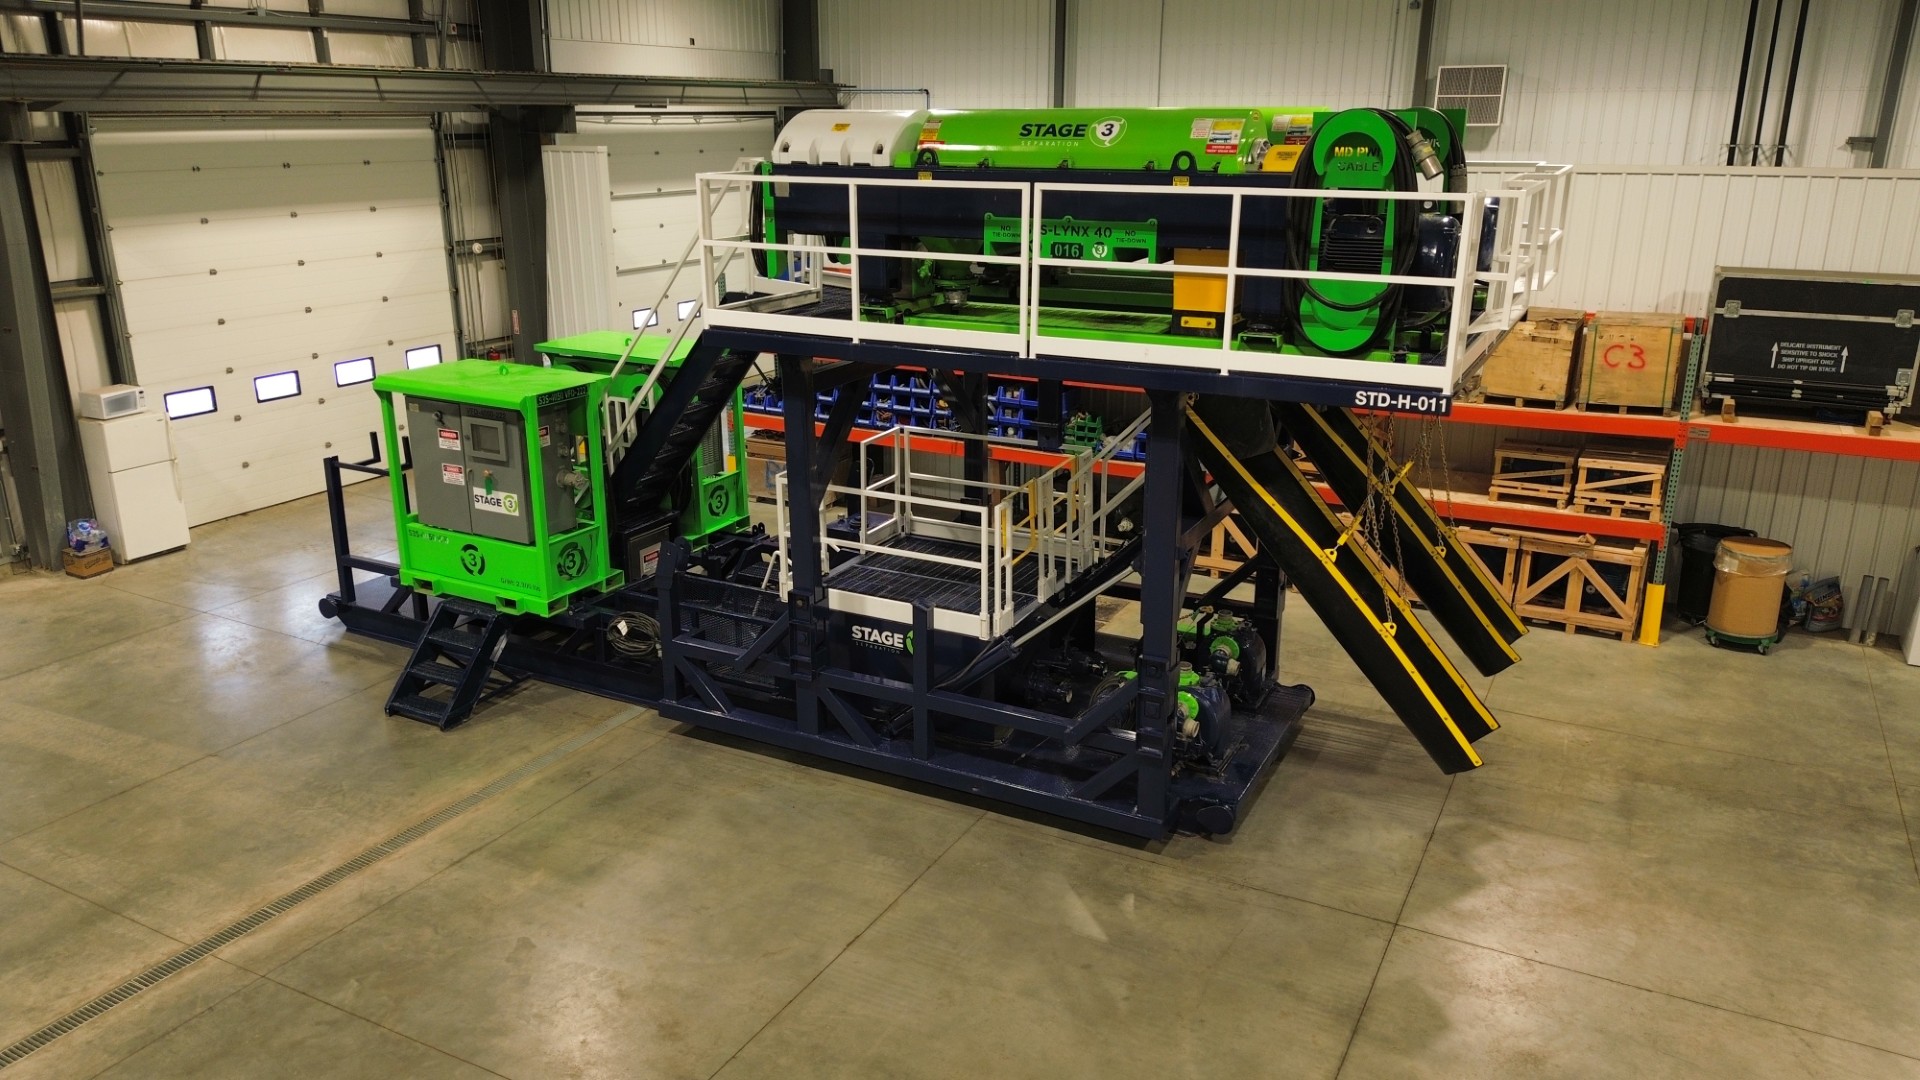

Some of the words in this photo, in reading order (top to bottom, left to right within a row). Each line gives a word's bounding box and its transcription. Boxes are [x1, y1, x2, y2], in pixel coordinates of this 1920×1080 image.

[1019, 123, 1088, 138] STAGE
[1101, 123, 1114, 137] 3
[1334, 146, 1353, 157] MD
[1338, 161, 1380, 172] CABLE
[1094, 226, 1112, 238] 40
[1054, 244, 1079, 258] 016
[1604, 344, 1645, 369] C3
[1355, 391, 1447, 412] STD-H-011
[474, 494, 502, 507] STAGE
[468, 553, 477, 567] 3
[566, 550, 577, 571] 3
[851, 625, 904, 648] STAGE
